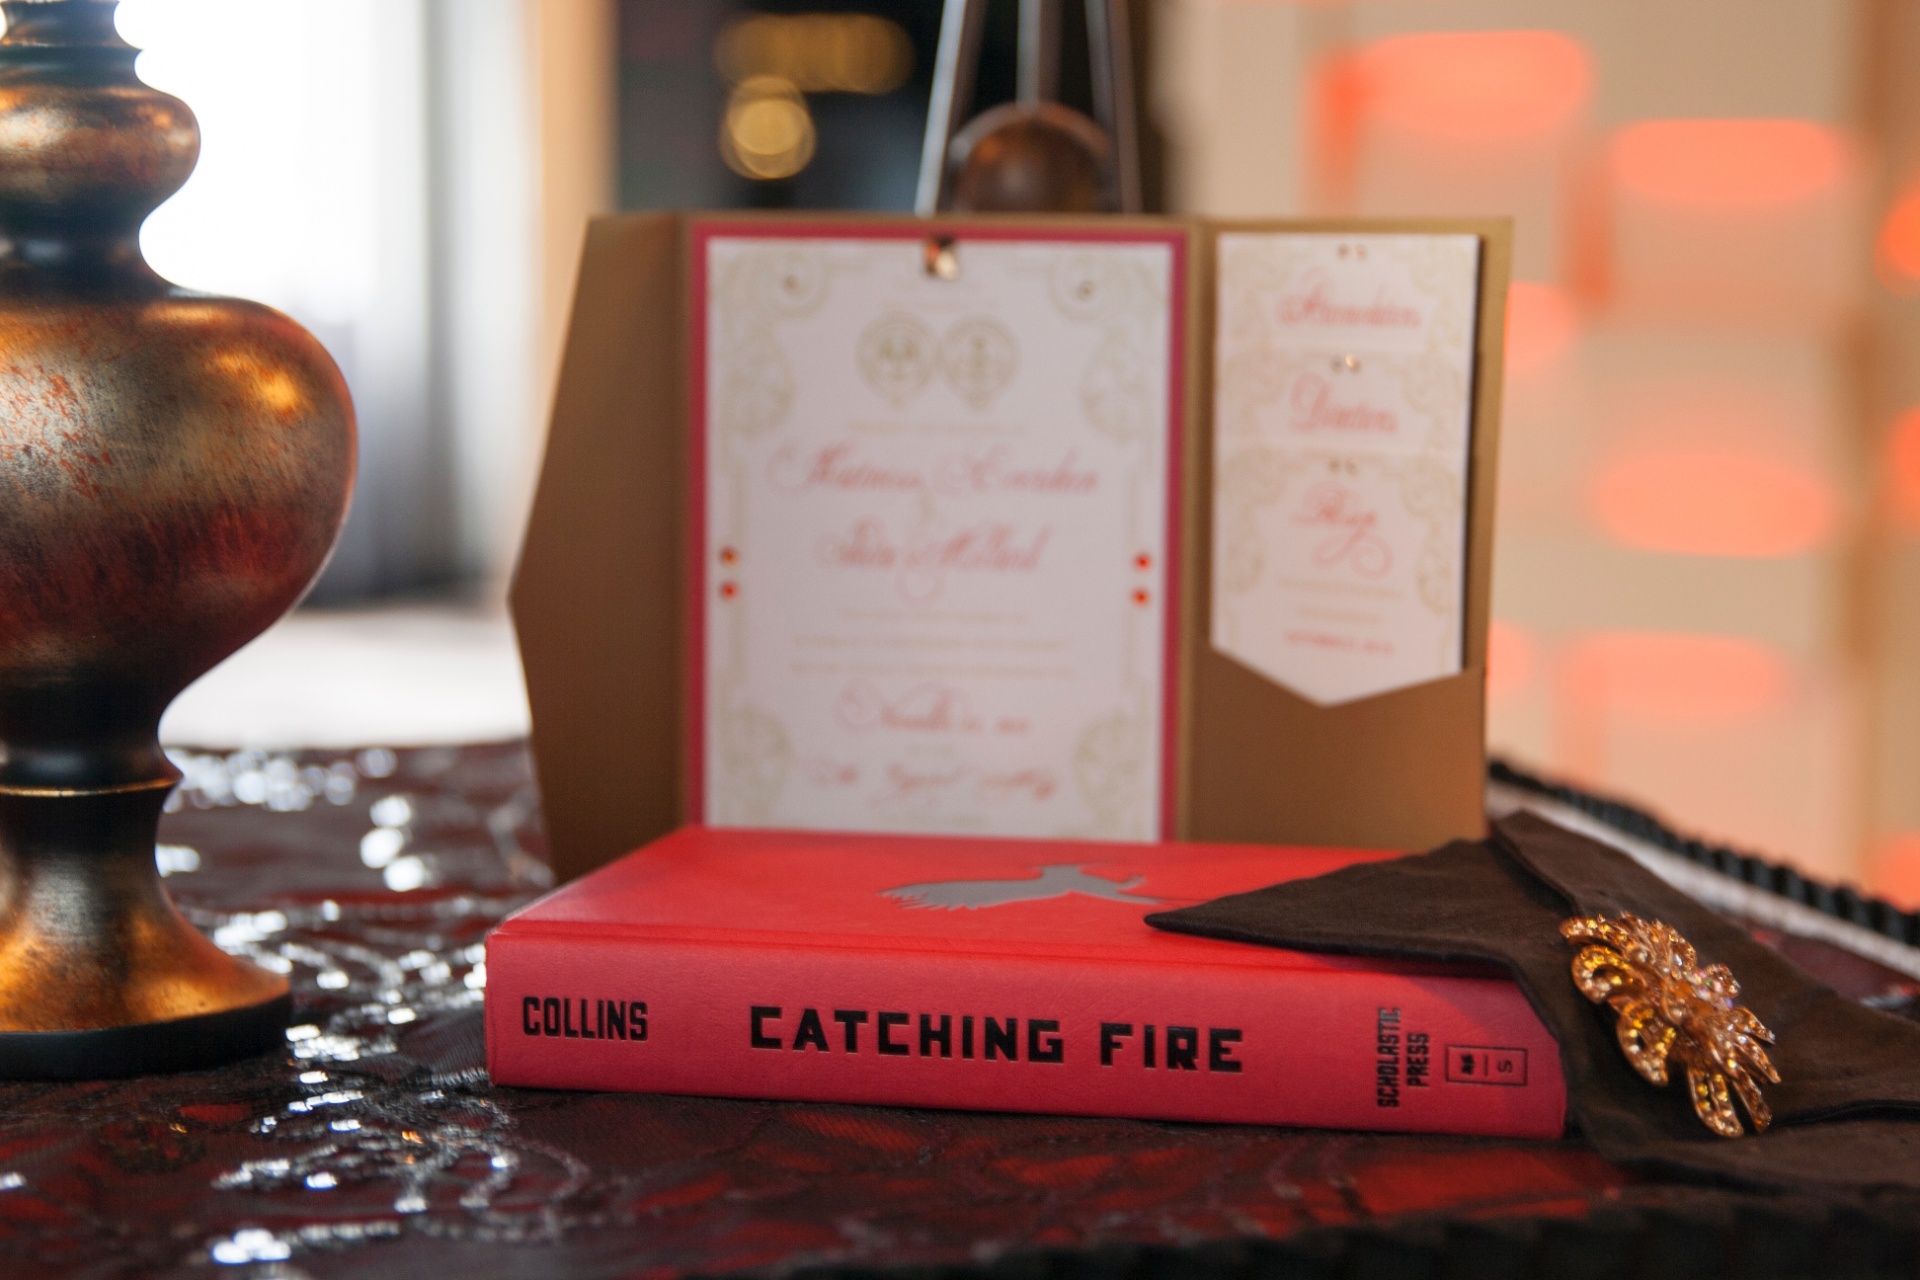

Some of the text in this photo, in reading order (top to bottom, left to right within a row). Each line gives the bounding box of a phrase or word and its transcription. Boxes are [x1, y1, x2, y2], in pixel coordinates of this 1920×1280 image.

[522, 996, 648, 1041] COLLINS
[751, 1005, 1243, 1073] CATCHING FIRE
[1377, 1007, 1401, 1107] SCHOLASTIC
[1406, 1033, 1430, 1087] PRESS
